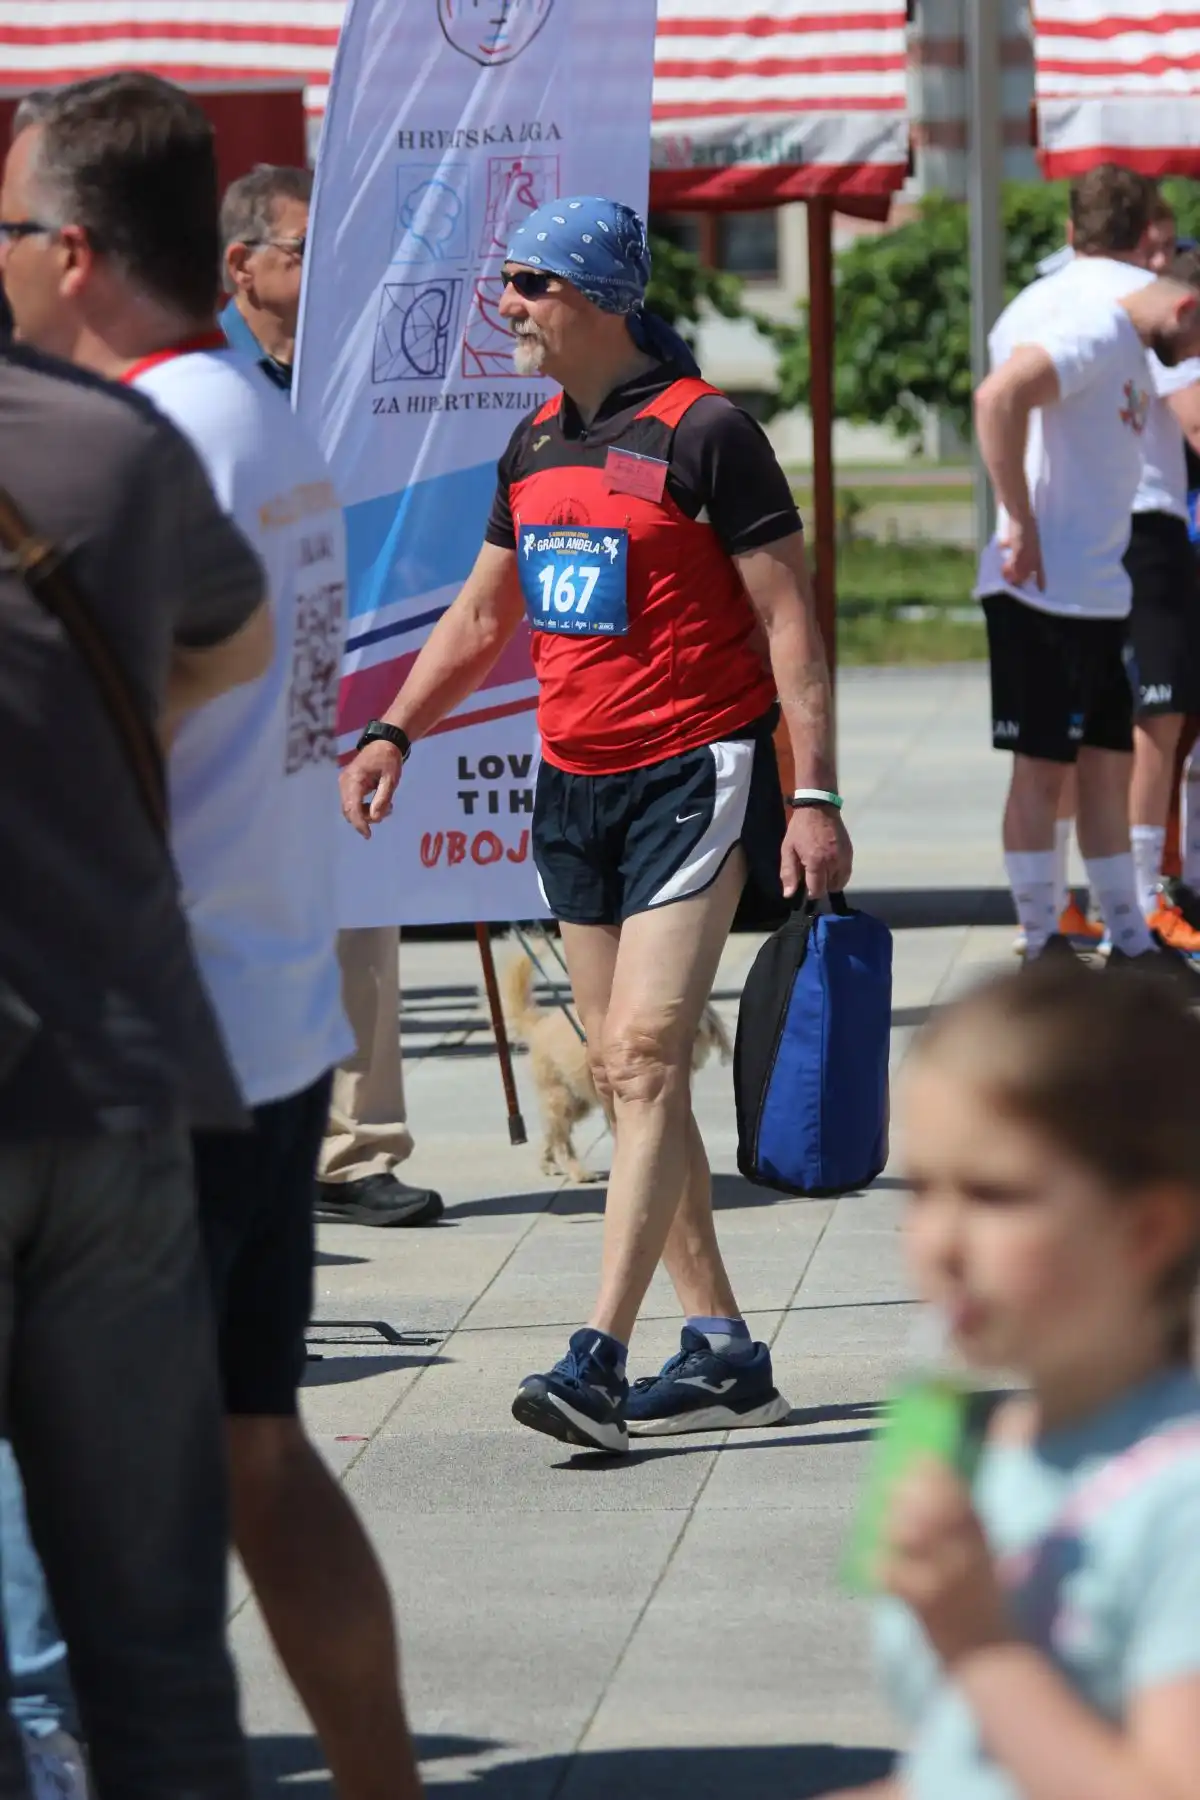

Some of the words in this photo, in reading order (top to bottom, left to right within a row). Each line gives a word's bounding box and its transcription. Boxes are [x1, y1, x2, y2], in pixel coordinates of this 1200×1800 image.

[397, 123, 514, 150] HRVTSKA
[371, 396, 400, 415] ZA
[537, 537, 565, 552] GRADA
[538, 564, 601, 614] 167
[457, 754, 533, 780] LOV
[457, 789, 534, 815] TIH
[420, 829, 530, 868] UBOJ
